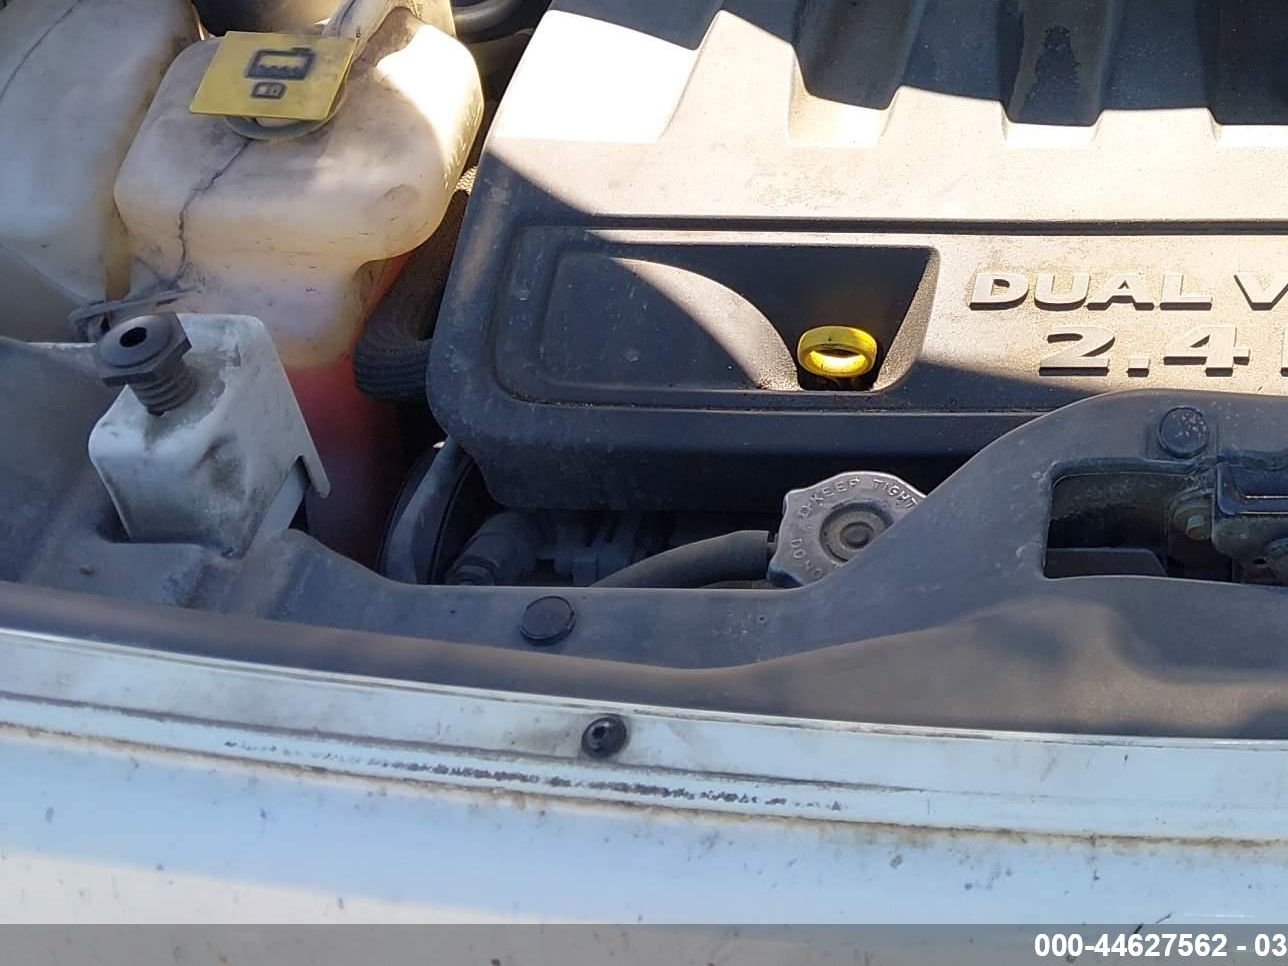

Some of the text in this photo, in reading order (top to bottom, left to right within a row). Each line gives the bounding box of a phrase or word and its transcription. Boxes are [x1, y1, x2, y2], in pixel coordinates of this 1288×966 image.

[969, 272, 1212, 311] DUAL
[809, 476, 918, 509] KEEP TIGHT
